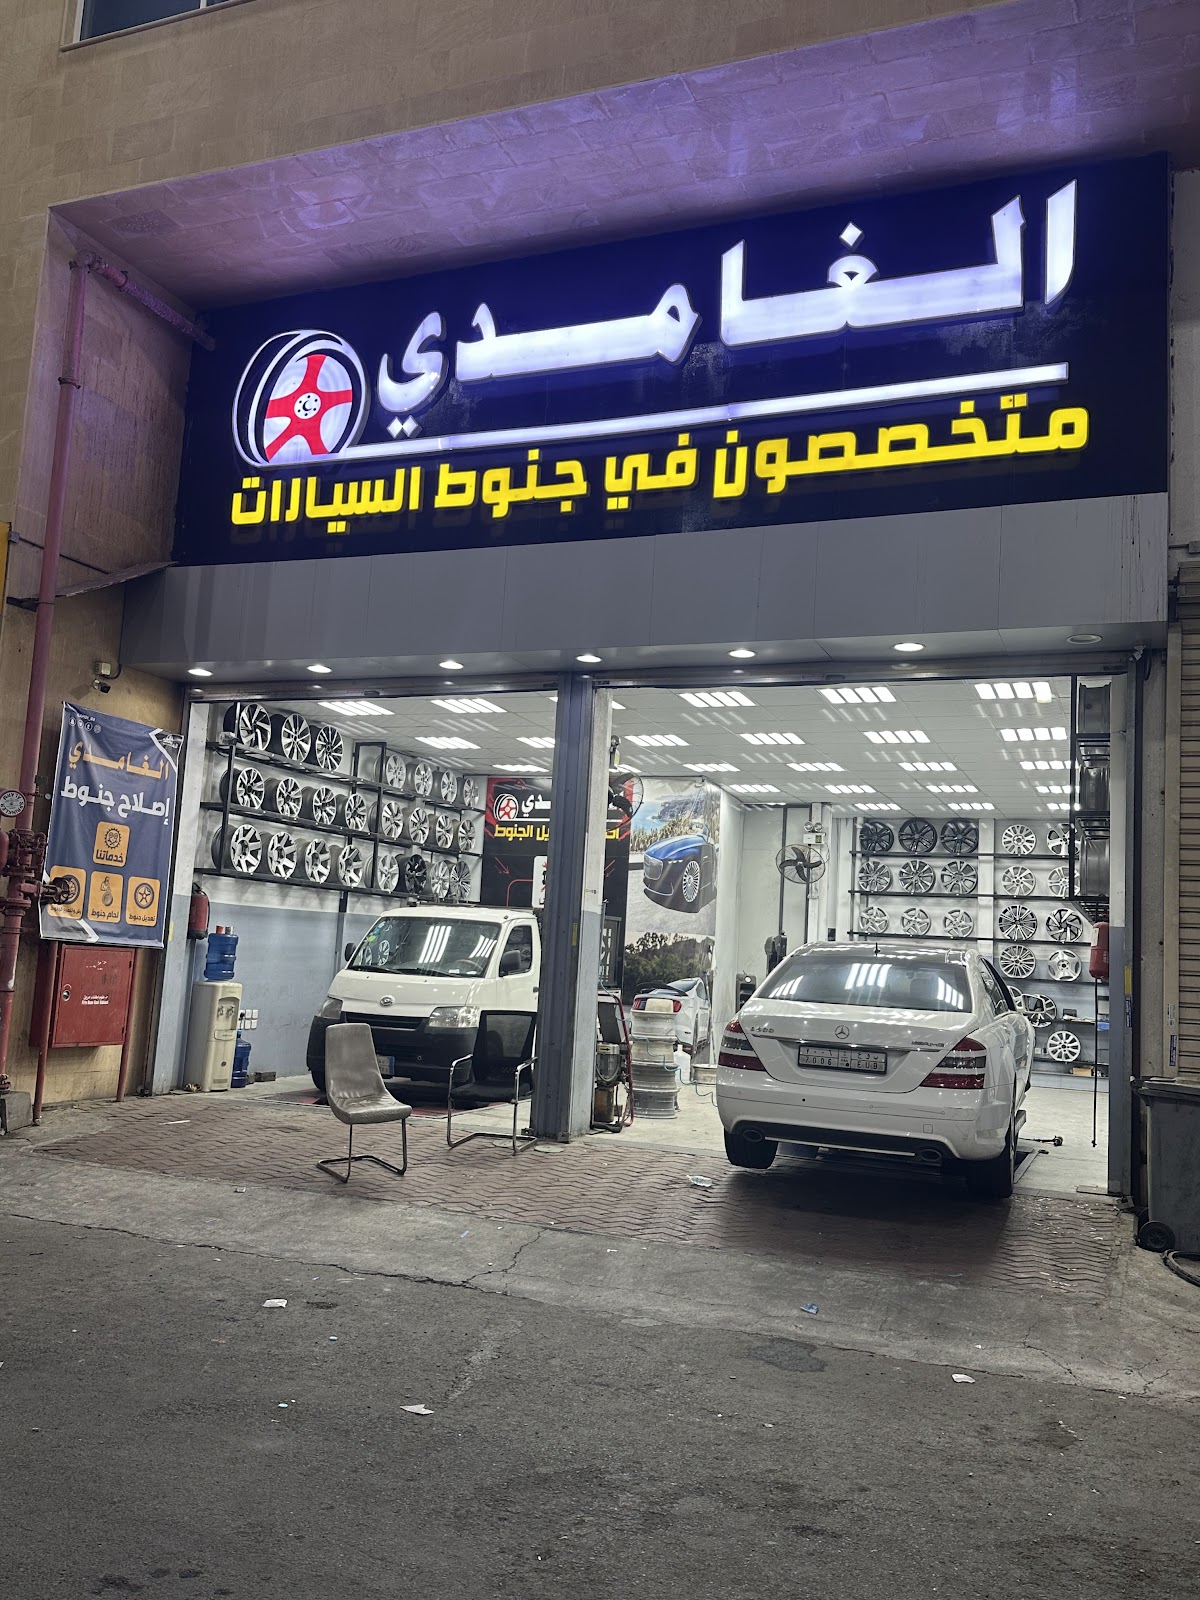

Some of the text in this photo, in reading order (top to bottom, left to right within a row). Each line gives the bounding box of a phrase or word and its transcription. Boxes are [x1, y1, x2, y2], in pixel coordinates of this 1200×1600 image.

[375, 178, 1078, 438] الغامدي
[231, 393, 1089, 533] متخصصون في جنوط السيارات
[68, 741, 169, 780] الغامدي
[60, 775, 171, 826] إصلاح جنوط
[494, 823, 534, 842] الجنوط
[95, 848, 124, 863] خدماتنا
[91, 908, 119, 920] لحام جنوط
[128, 913, 141, 921] جنوط
[805, 1057, 832, 1066] 7006
